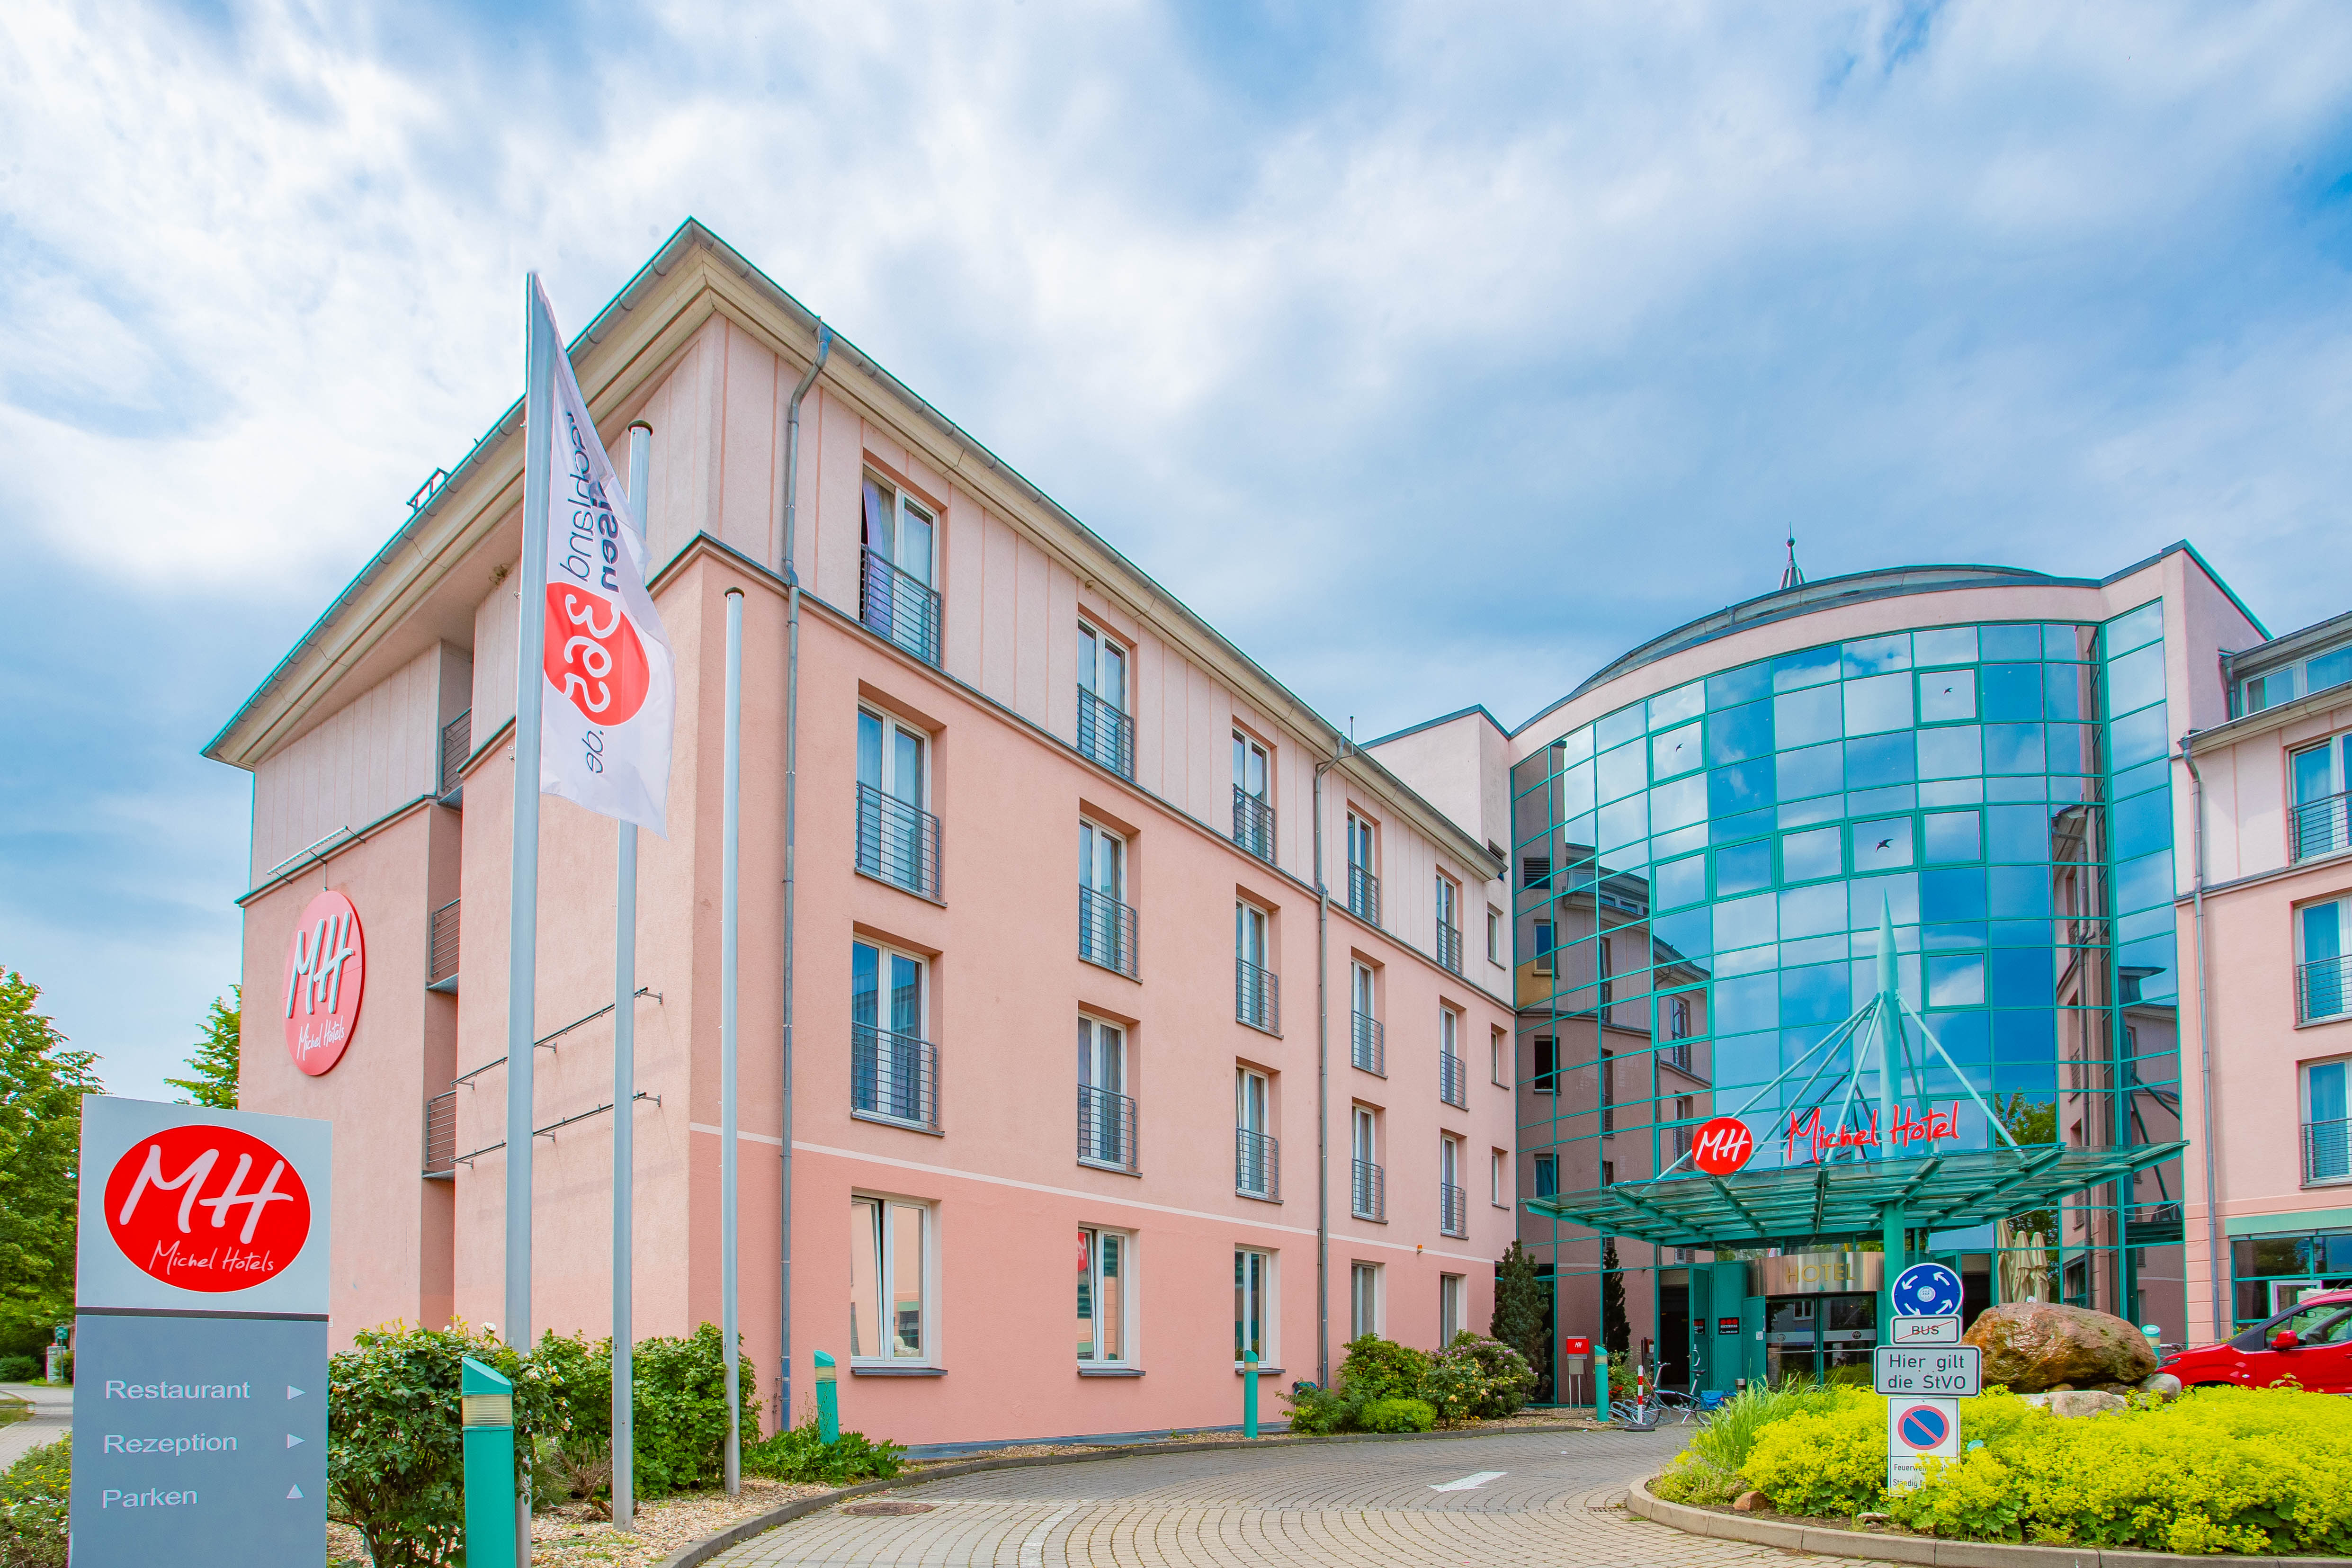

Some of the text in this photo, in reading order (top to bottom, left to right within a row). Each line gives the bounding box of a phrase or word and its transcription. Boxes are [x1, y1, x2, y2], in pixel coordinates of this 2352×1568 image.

[286, 911, 354, 1019] MH
[296, 1015, 345, 1061] Michel Hotels
[1787, 1101, 1959, 1165] Michel Hotel
[1695, 1129, 1750, 1162] MH
[119, 1144, 294, 1245] MH
[149, 1239, 274, 1275] Michel Hotels
[1786, 1263, 1857, 1284] HOTEL
[1911, 1325, 1940, 1335] BUS
[1888, 1353, 1965, 1372] Hier gilt
[105, 1380, 251, 1399] Restaurant
[1887, 1374, 1966, 1389] die StVO
[104, 1433, 238, 1457] Rezeption
[102, 1487, 198, 1508] Parken
